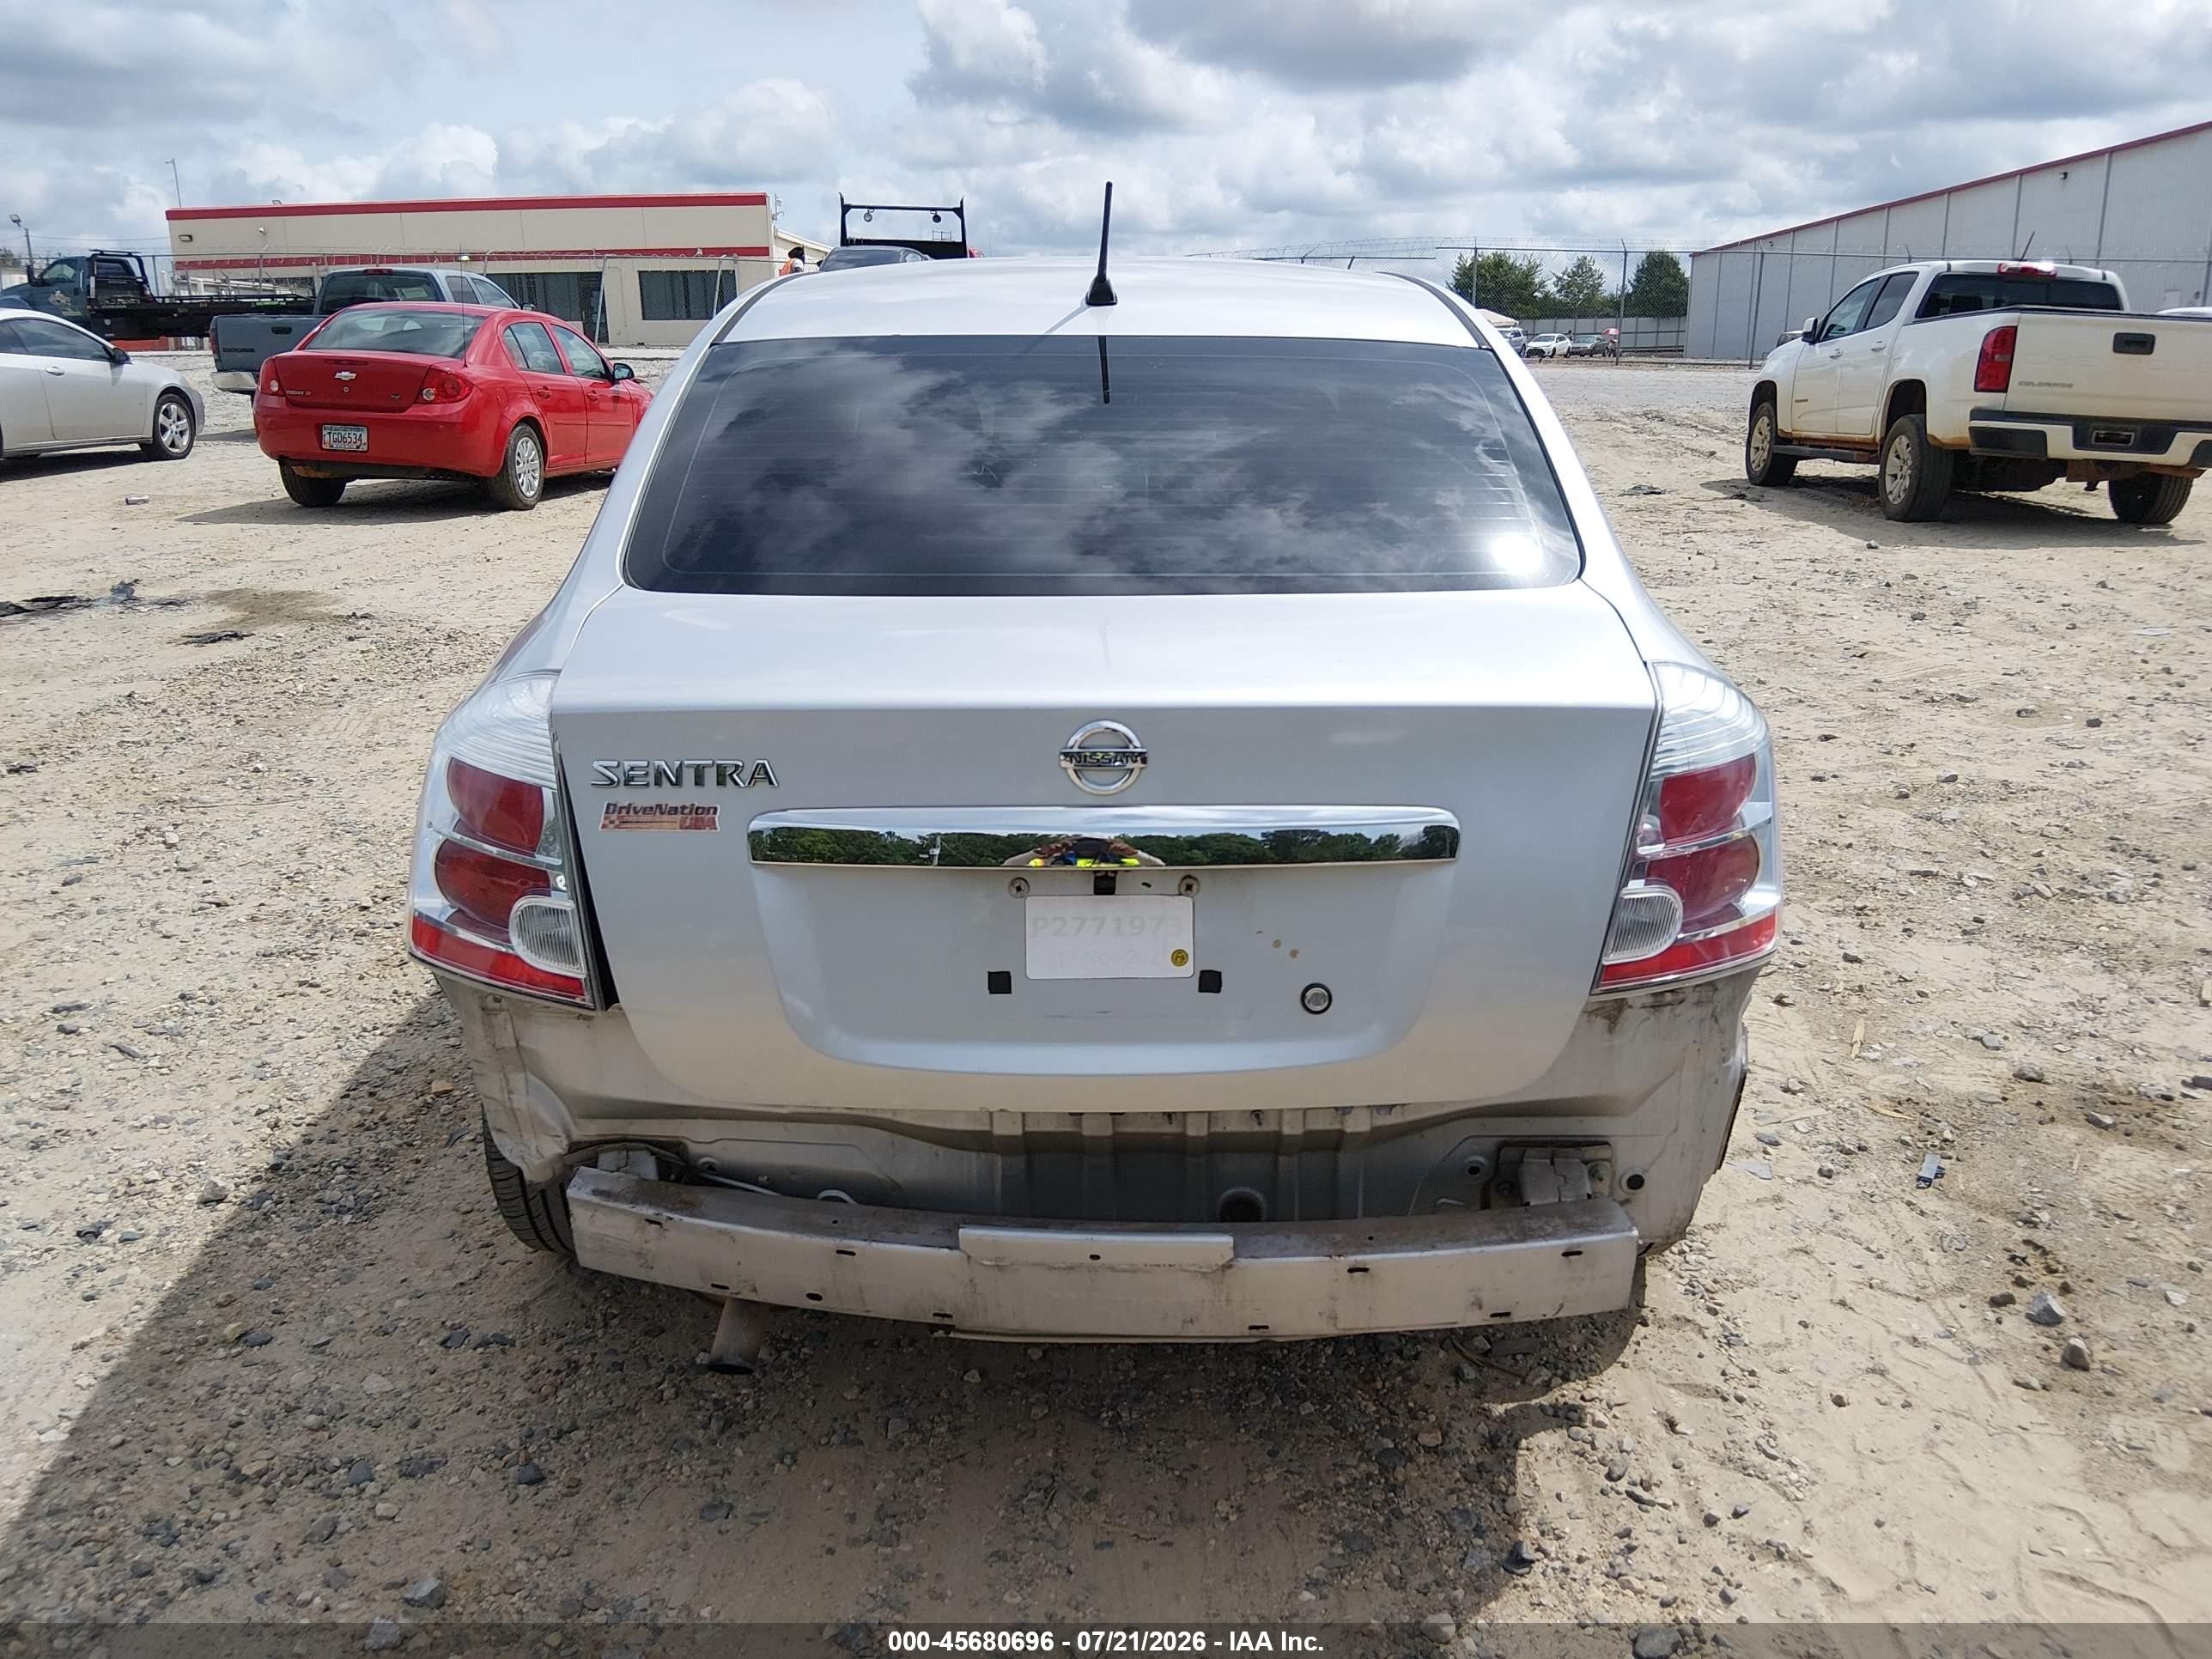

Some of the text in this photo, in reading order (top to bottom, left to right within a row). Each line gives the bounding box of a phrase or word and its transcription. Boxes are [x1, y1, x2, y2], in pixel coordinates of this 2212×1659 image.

[326, 431, 362, 445] TGD6534
[1068, 751, 1139, 765] NISSAN
[591, 758, 779, 787] SENTRA
[604, 802, 718, 816] DriveNation
